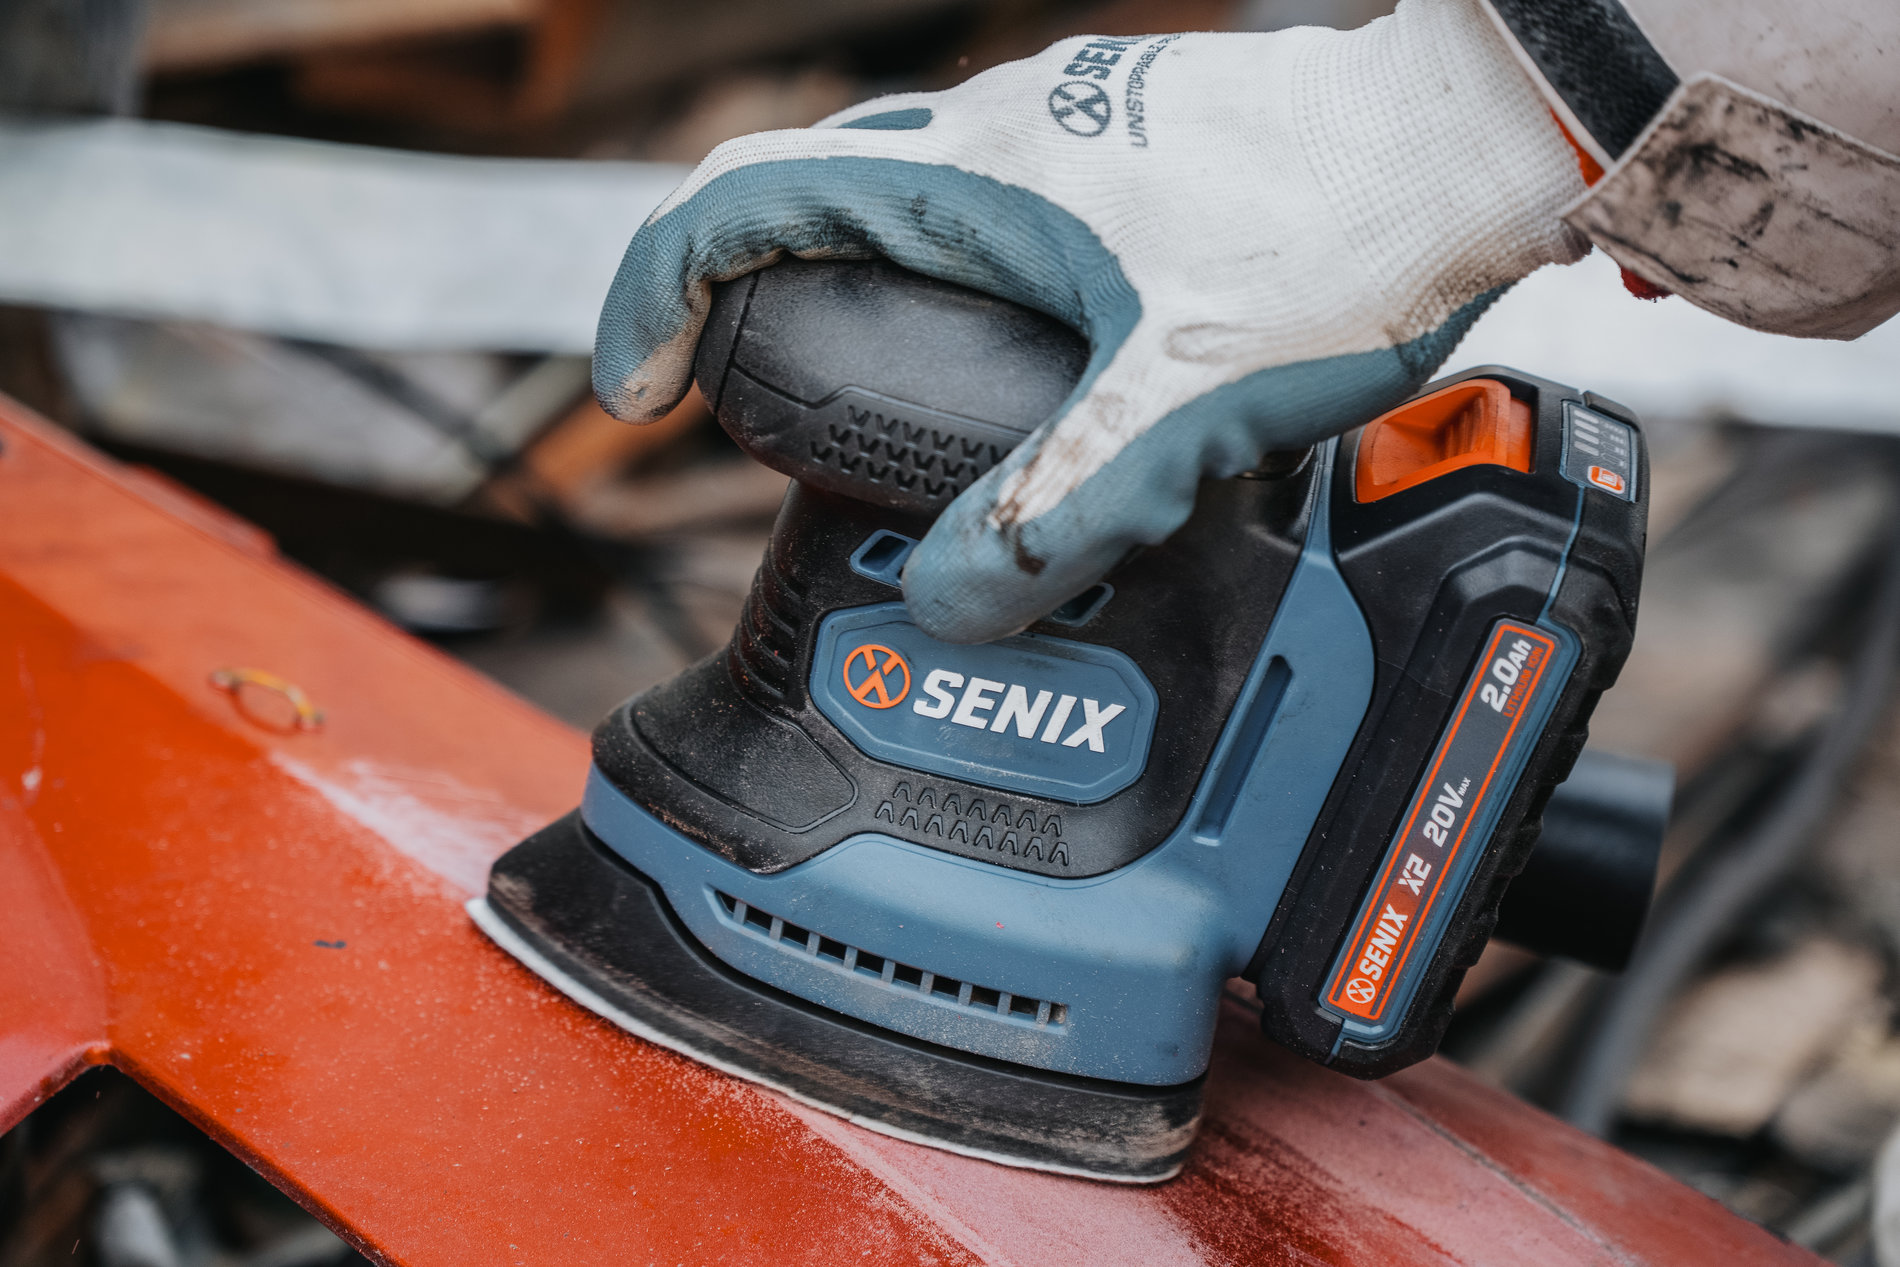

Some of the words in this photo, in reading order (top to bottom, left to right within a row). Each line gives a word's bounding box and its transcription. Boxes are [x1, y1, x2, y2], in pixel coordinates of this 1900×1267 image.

[912, 668, 1127, 753] SENIX
[1480, 639, 1532, 713] 2.0Ah
[1503, 668, 1532, 718] LITHIUM
[1527, 646, 1545, 669] ION
[1359, 903, 1408, 981] SENIX
[1398, 853, 1432, 897] X2
